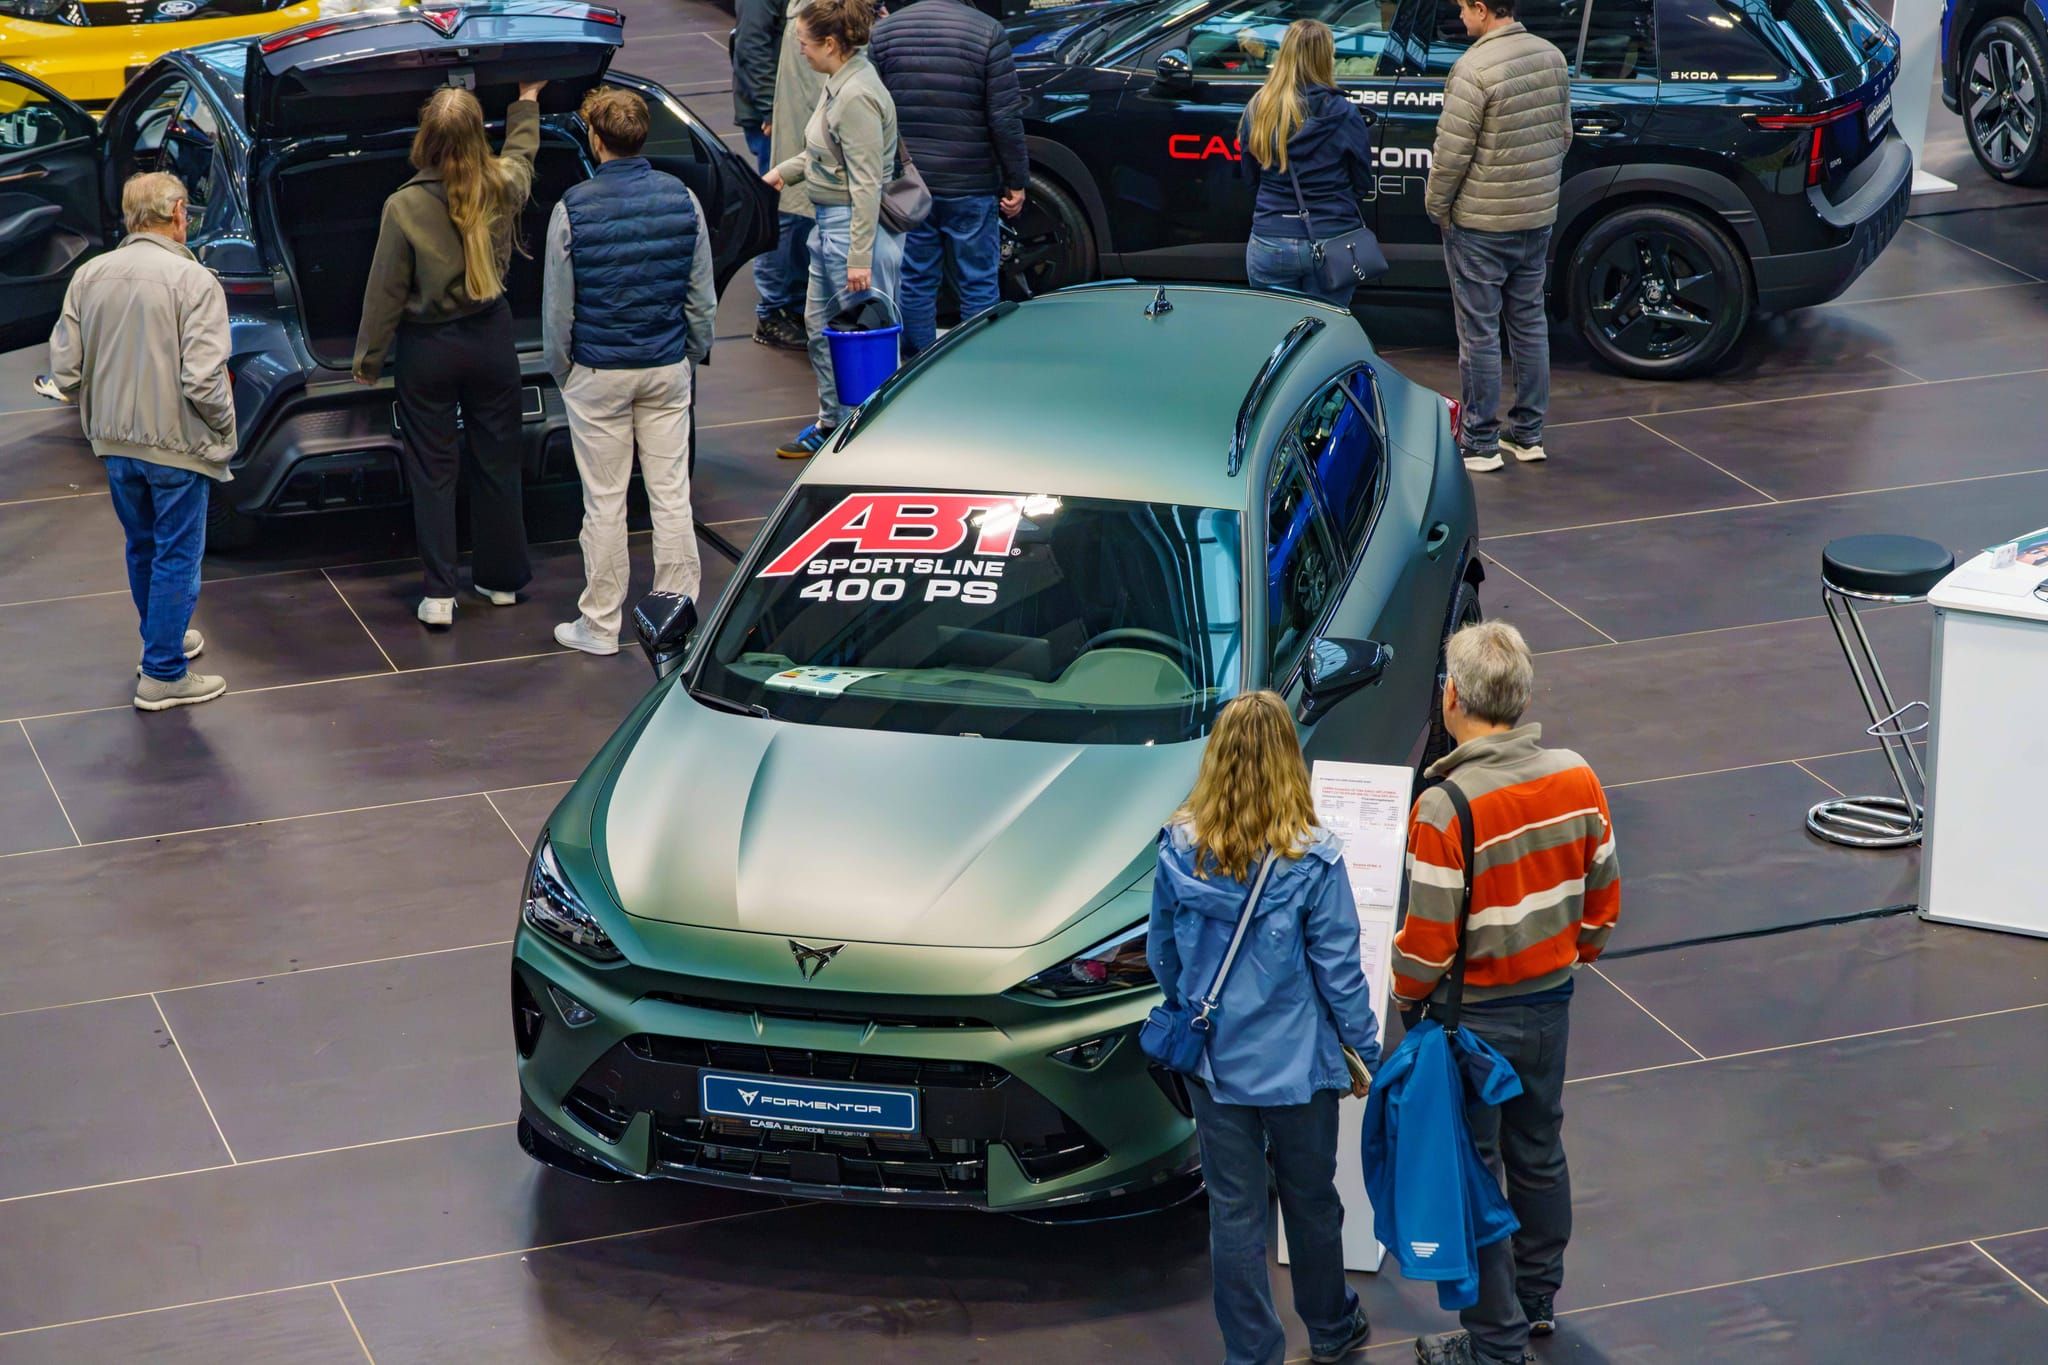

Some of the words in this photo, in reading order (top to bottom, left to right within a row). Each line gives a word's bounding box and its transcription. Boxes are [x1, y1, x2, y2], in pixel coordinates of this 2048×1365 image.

[1393, 92, 1444, 106] FAHR
[756, 493, 1028, 578] ABT
[807, 558, 1006, 577] SPORTSLINE
[800, 578, 906, 602] 400
[924, 579, 999, 604] PS
[761, 1096, 882, 1114] FORMENTOR
[750, 1119, 782, 1130] CASA
